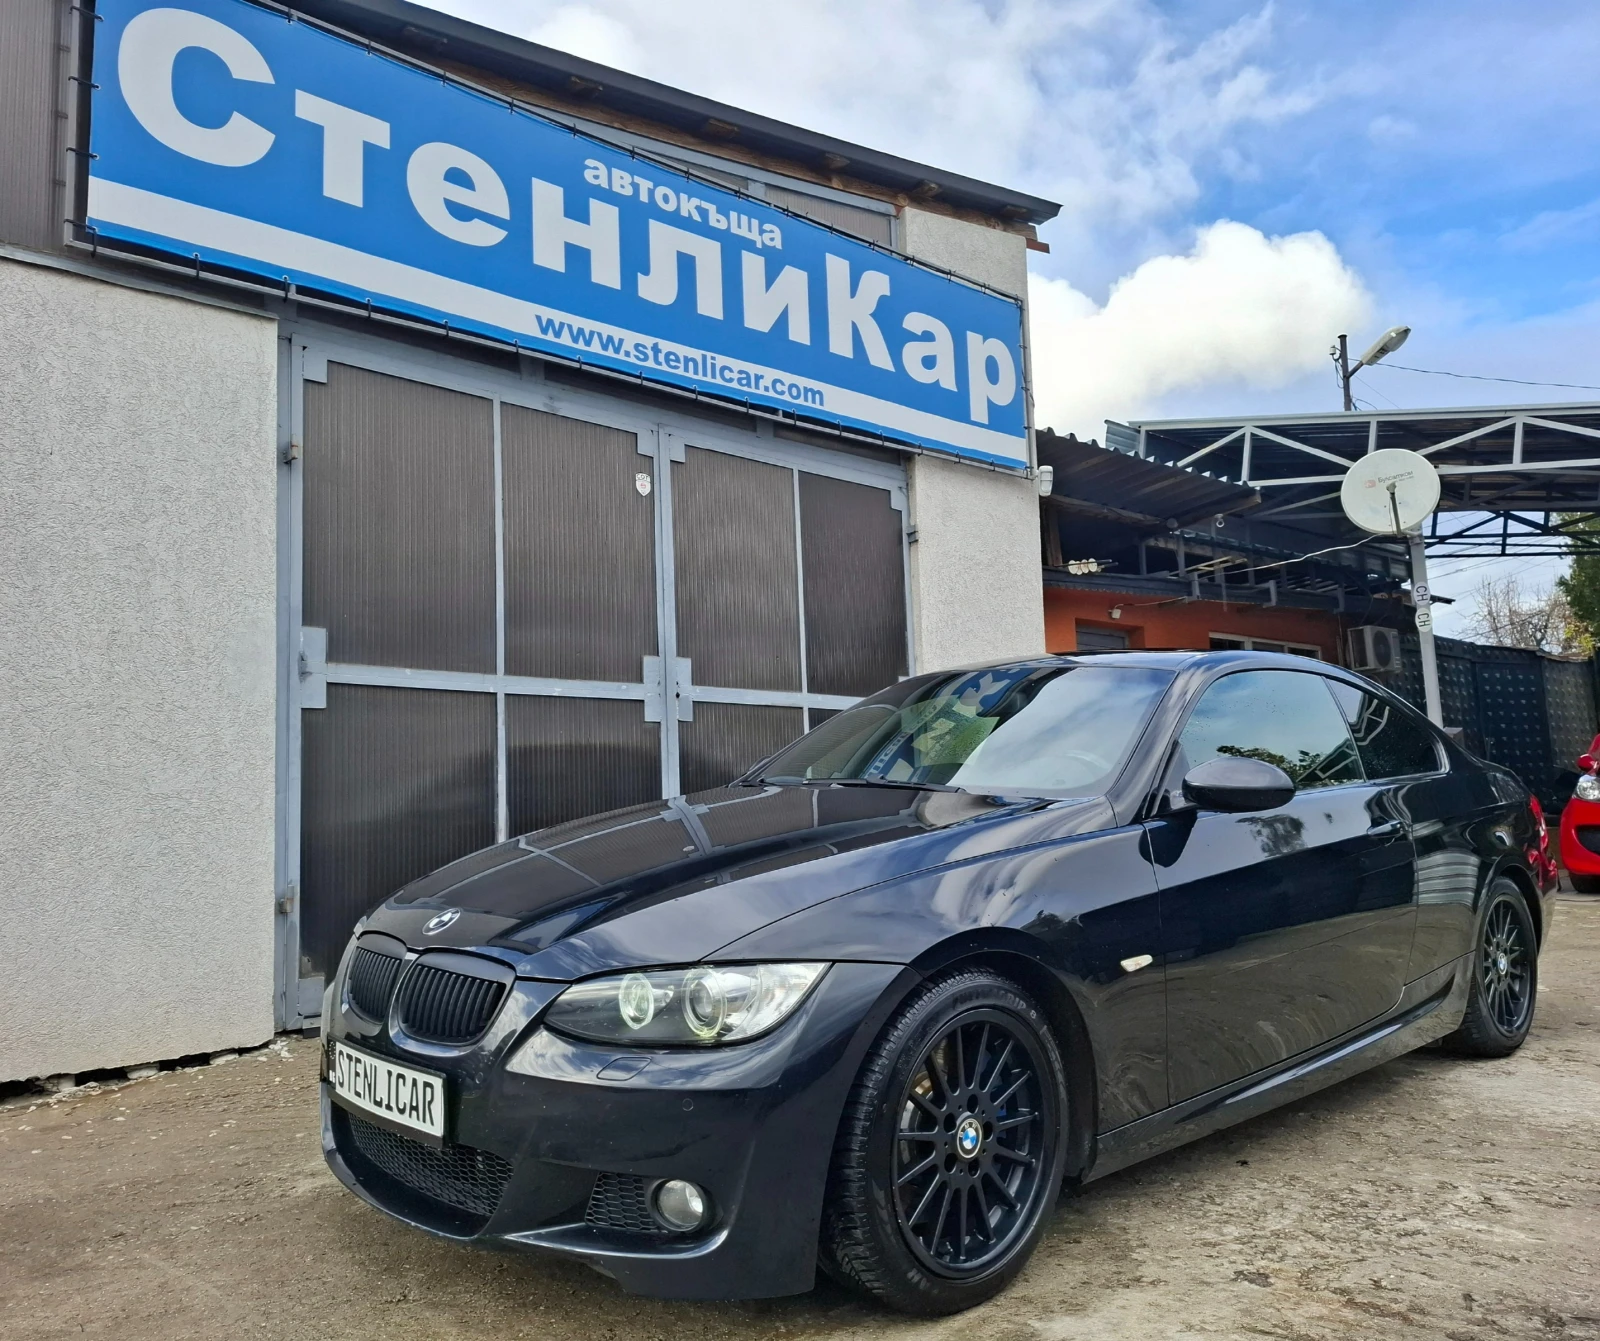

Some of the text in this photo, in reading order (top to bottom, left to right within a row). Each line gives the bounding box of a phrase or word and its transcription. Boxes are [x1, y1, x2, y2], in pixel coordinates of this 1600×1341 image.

[118, 8, 1016, 424] СтенлиКар
[584, 158, 782, 249] автокъща
[535, 314, 824, 406] www.stenlicar.com
[337, 1049, 435, 1127] STENLICAR
